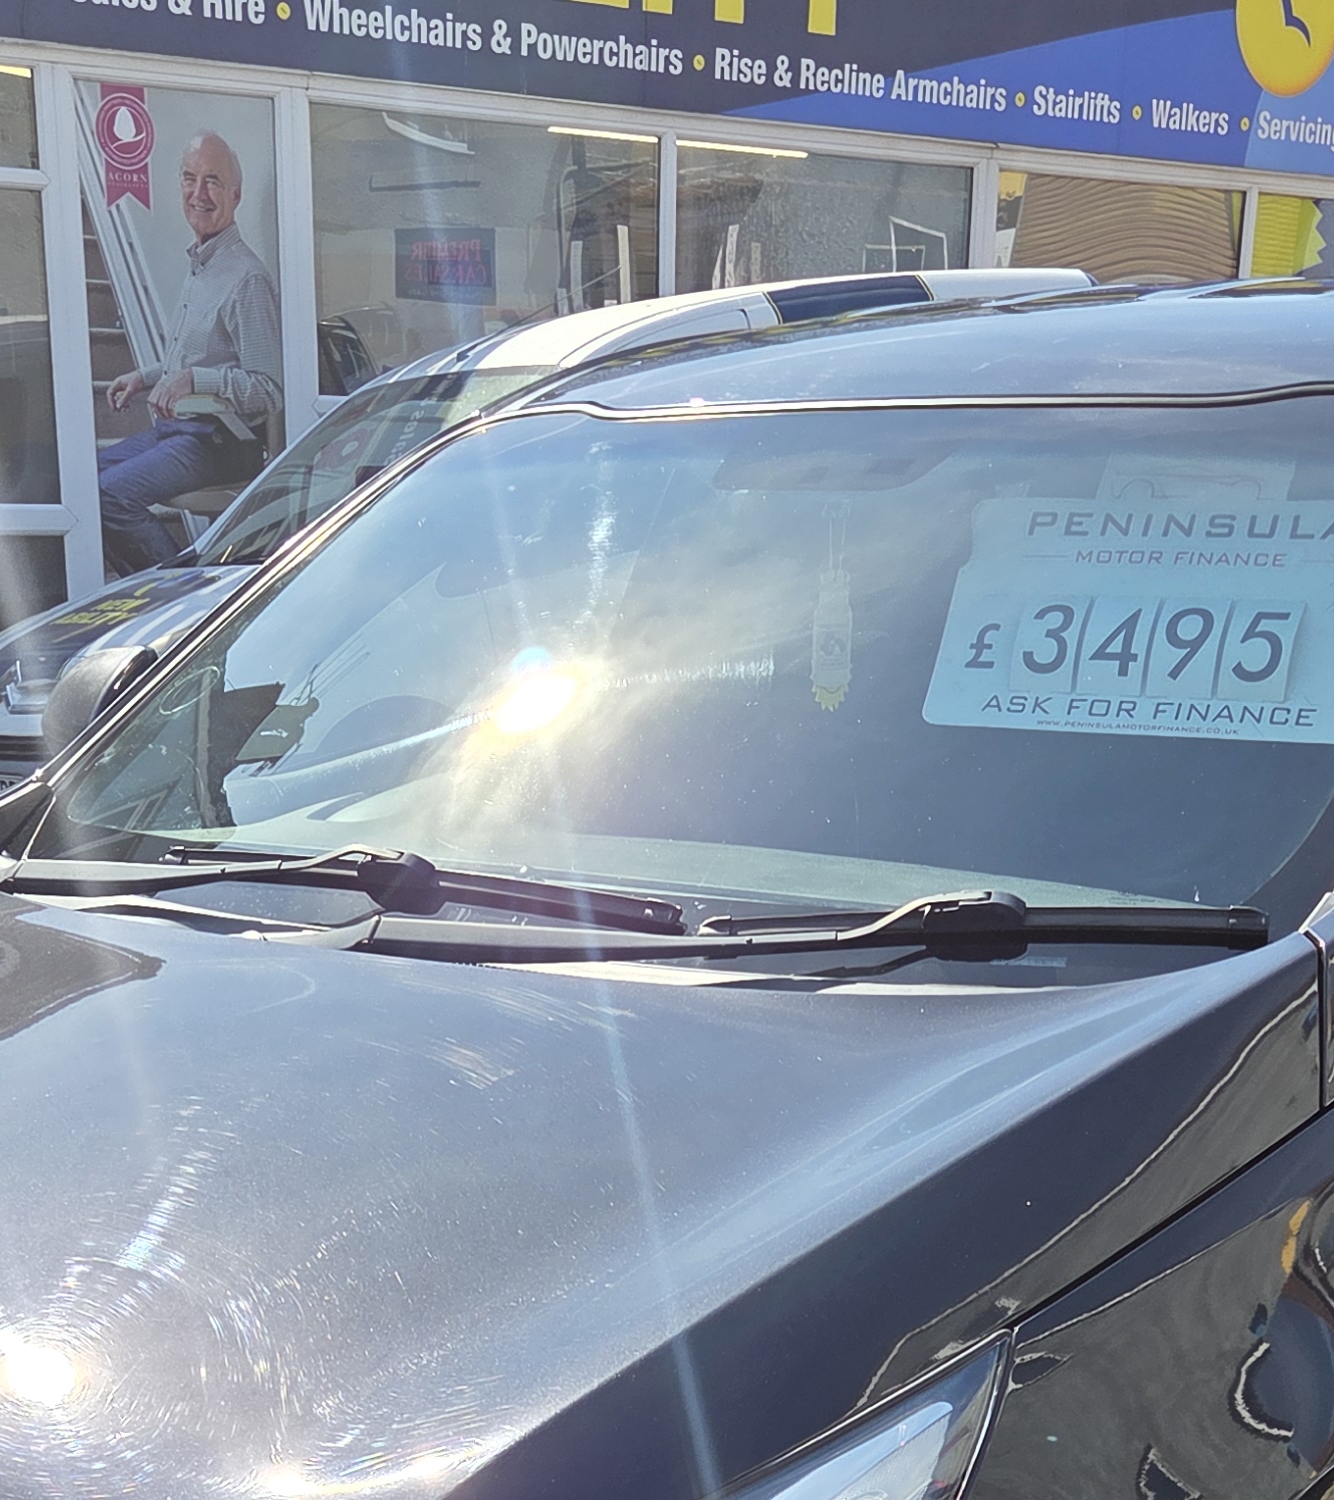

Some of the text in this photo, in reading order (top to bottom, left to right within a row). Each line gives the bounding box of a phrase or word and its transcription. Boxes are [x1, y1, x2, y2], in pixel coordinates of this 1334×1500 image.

[303, 0, 482, 51] Wheelchairs
[490, 19, 512, 55] &
[520, 23, 683, 75] Powerchairs
[715, 47, 766, 85] Rise
[773, 55, 792, 88] &
[800, 58, 884, 98] Recline
[891, 69, 1006, 112] Armchairs
[1033, 85, 1121, 124] Stairlifts
[1151, 99, 1228, 135] Walkers
[107, 171, 148, 183] ACORN
[1075, 549, 1287, 568] MOTOR FINANCE
[981, 694, 1318, 728] ASK FOR FINANCE
